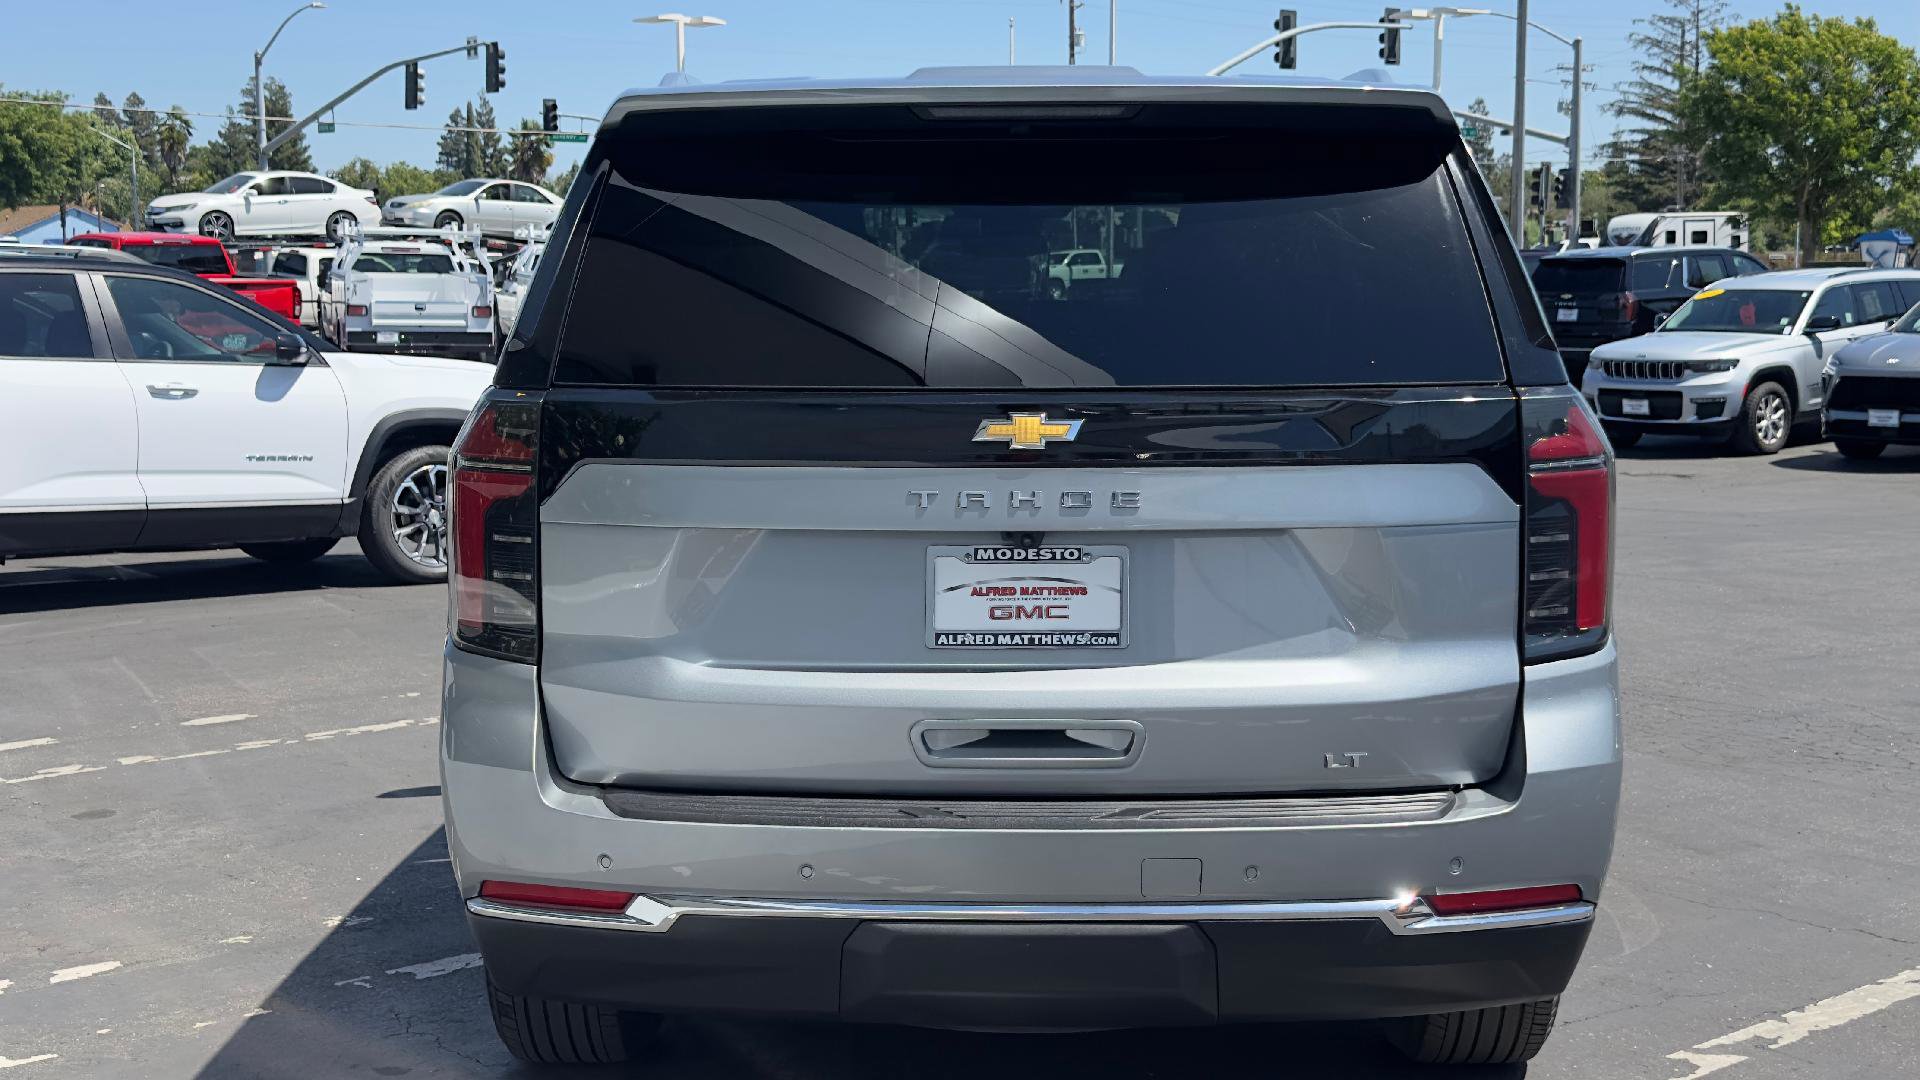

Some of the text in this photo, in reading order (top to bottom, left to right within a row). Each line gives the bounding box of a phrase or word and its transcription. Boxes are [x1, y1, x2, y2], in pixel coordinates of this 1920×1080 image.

[907, 490, 1141, 509] TAHOE
[976, 548, 1080, 561] MODESTO
[970, 586, 1088, 597] ALFRED MATTHEWS
[988, 604, 1070, 621] GMC
[937, 633, 994, 646] ALFRED
[1323, 751, 1368, 769] LT
